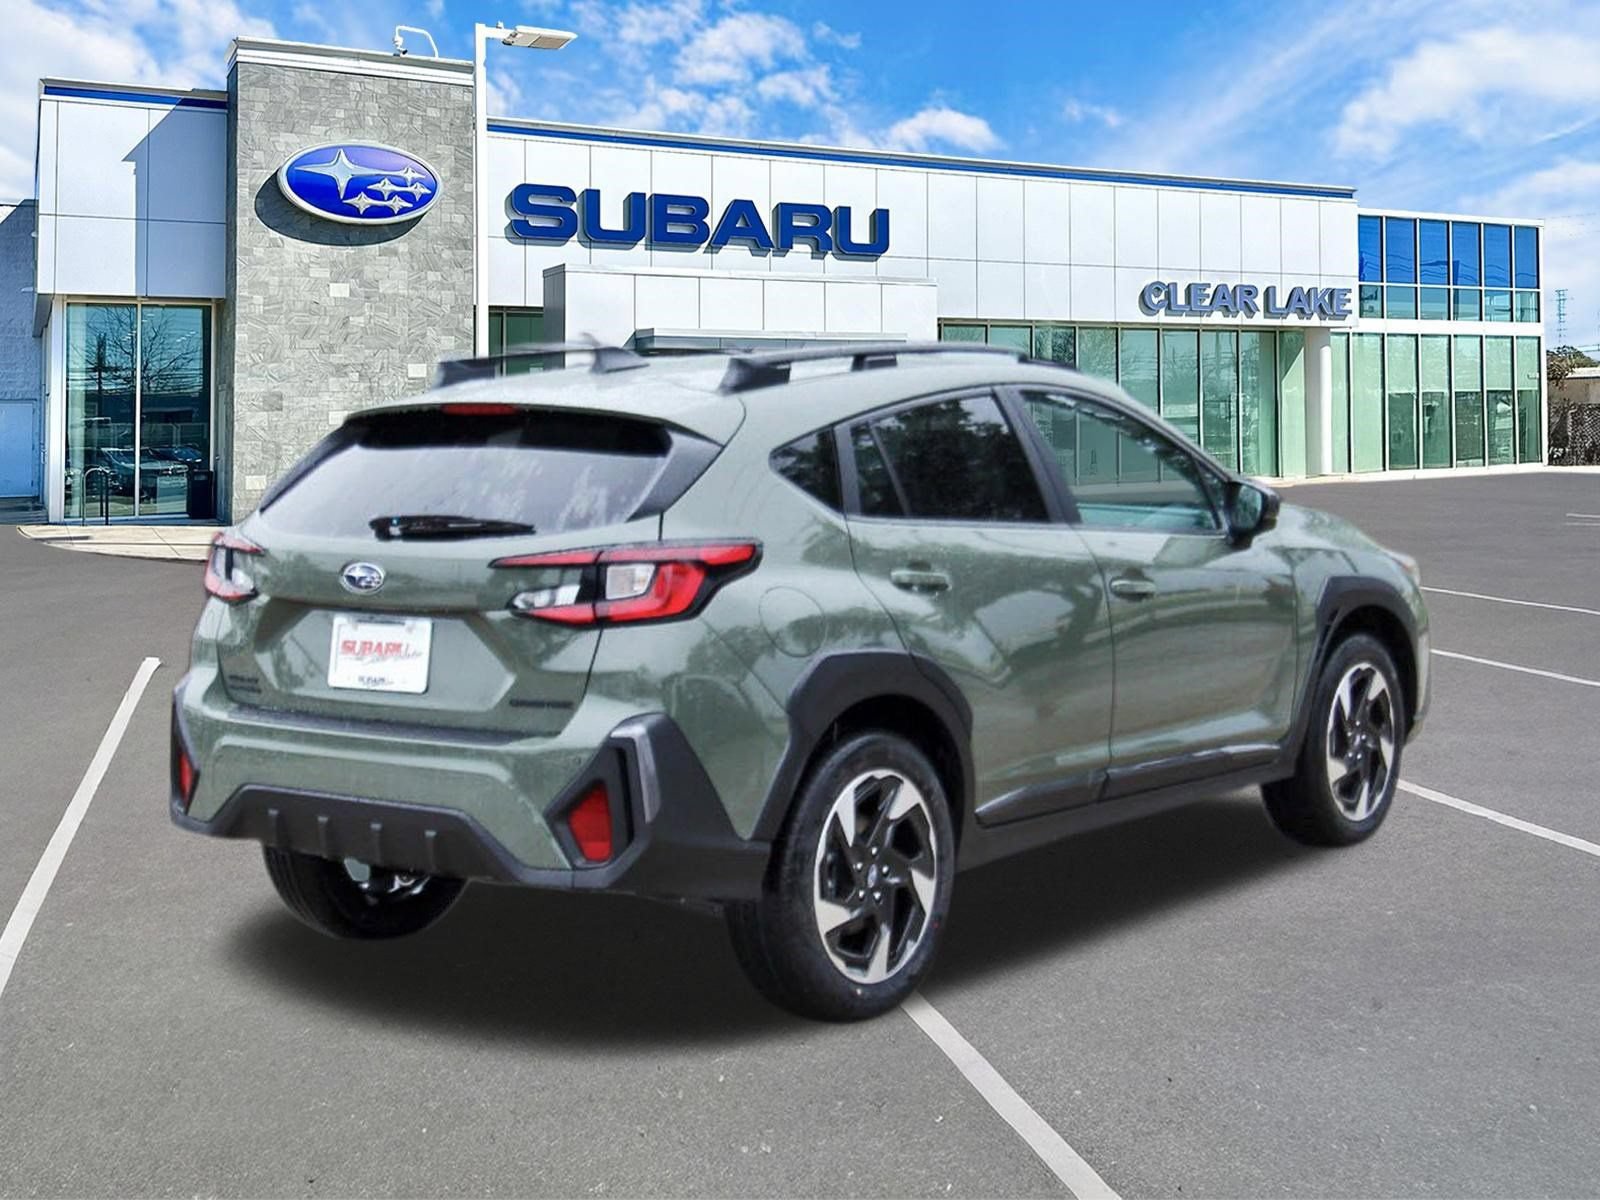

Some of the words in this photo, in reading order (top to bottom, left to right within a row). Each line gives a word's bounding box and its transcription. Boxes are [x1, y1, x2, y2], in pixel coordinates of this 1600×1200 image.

[507, 183, 890, 260] SUBARU
[1139, 281, 1261, 319] CLEAR
[1263, 286, 1353, 321] LAKE
